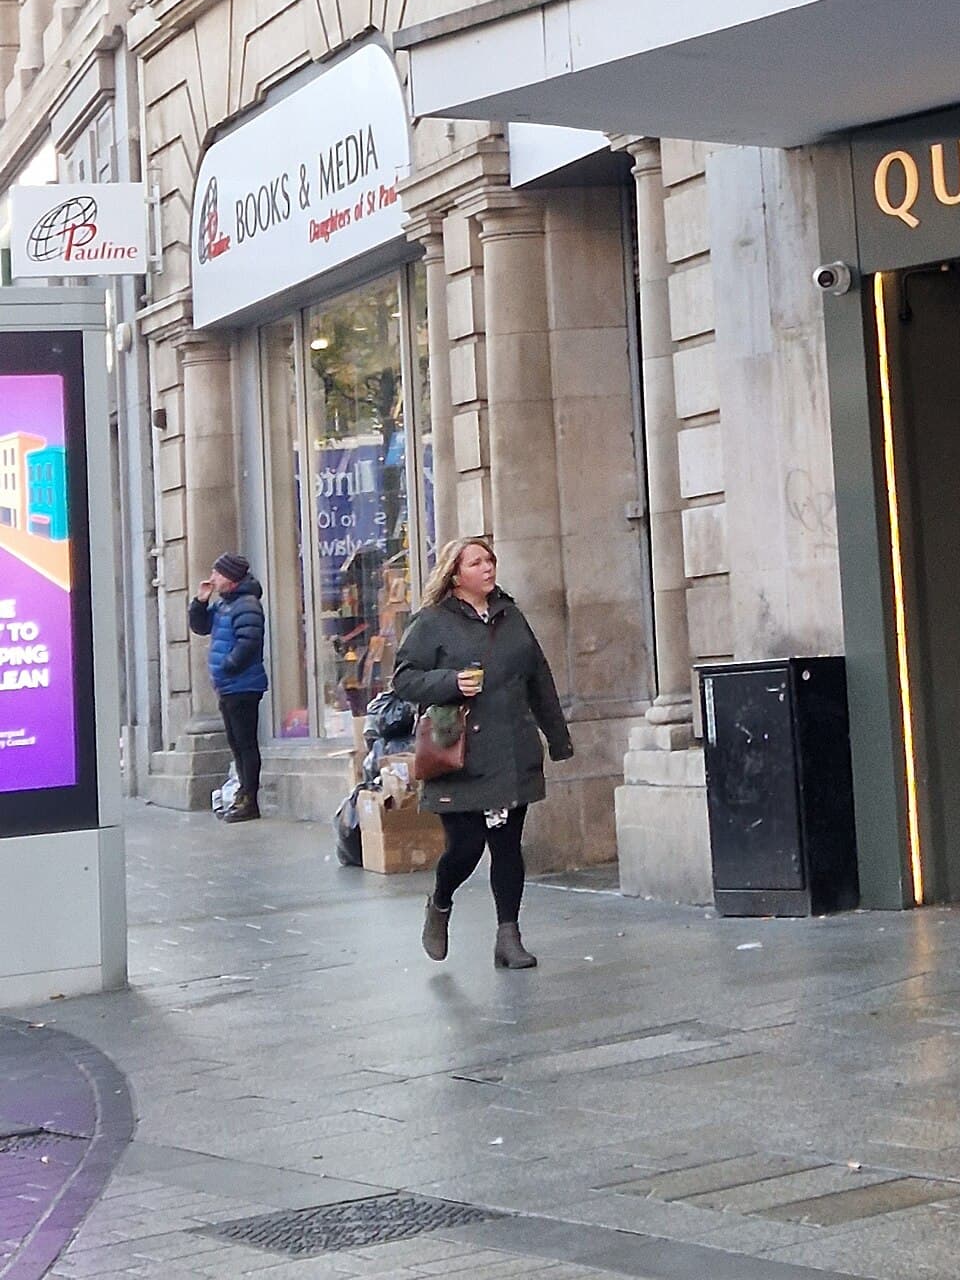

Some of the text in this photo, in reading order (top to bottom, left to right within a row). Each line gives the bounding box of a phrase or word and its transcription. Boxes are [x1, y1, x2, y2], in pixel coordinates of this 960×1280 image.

[236, 124, 379, 244] BOOKS & MEDIA
[309, 208, 351, 243] Daughters
[355, 193, 364, 221] of
[367, 191, 376, 215] St
[64, 223, 138, 261] Pauline
[7, 622, 39, 641] TO
